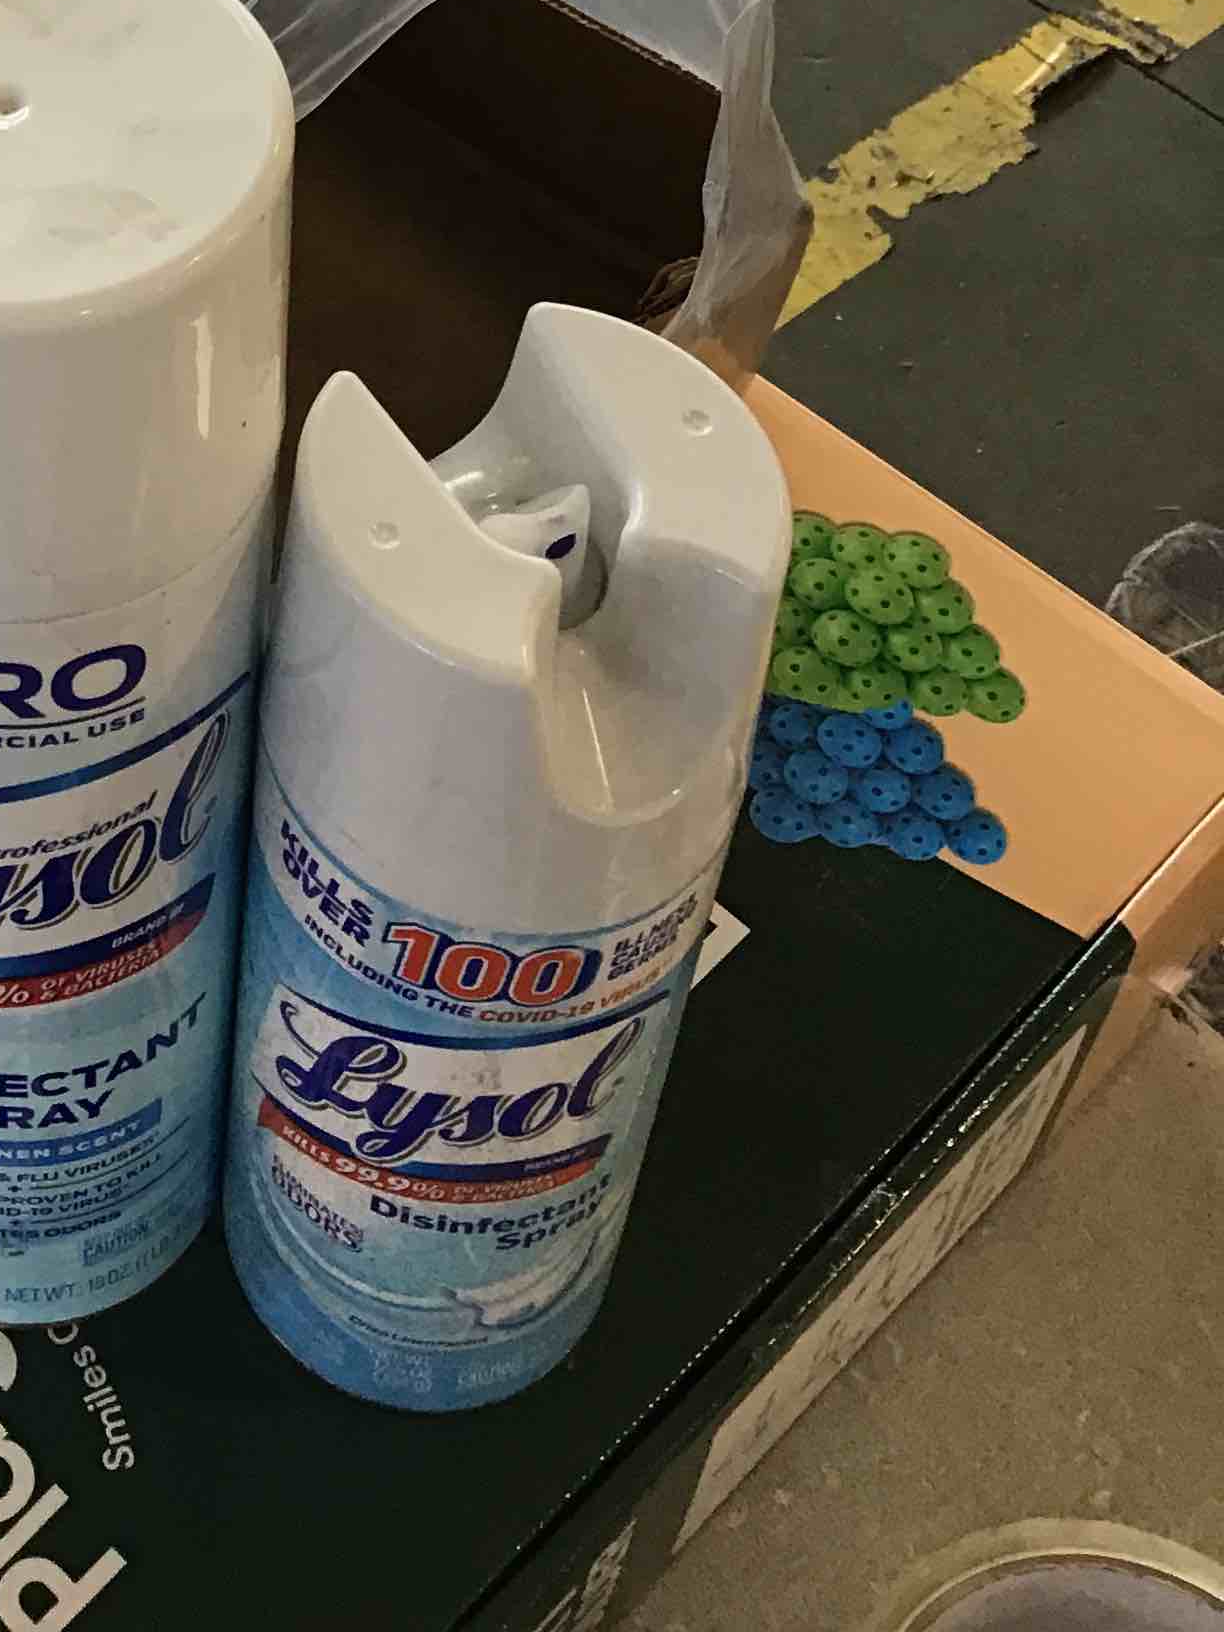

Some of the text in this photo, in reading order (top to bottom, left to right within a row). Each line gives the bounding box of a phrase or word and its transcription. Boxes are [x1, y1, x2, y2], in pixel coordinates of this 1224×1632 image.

[88, 707, 146, 740] USE
[279, 818, 375, 926] KILLS
[281, 849, 372, 948] OVER
[111, 914, 167, 949] BRAND
[303, 913, 418, 1002] INCLUDING
[424, 993, 475, 1020] THE
[478, 1002, 597, 1025] COVID-19
[383, 921, 604, 1007] 100
[276, 1000, 645, 1162] Lysol
[57, 1118, 143, 1157] SCENT
[280, 1123, 446, 1201] KILLS 99.9%
[17, 1170, 59, 1183] FLU
[93, 1177, 123, 1193] TO
[369, 1173, 612, 1235] Disinfectant
[43, 1209, 122, 1239] ODORS
[495, 1199, 604, 1251] Spray
[4, 1285, 42, 1304] NET
[73, 1346, 136, 1472] Smiles
